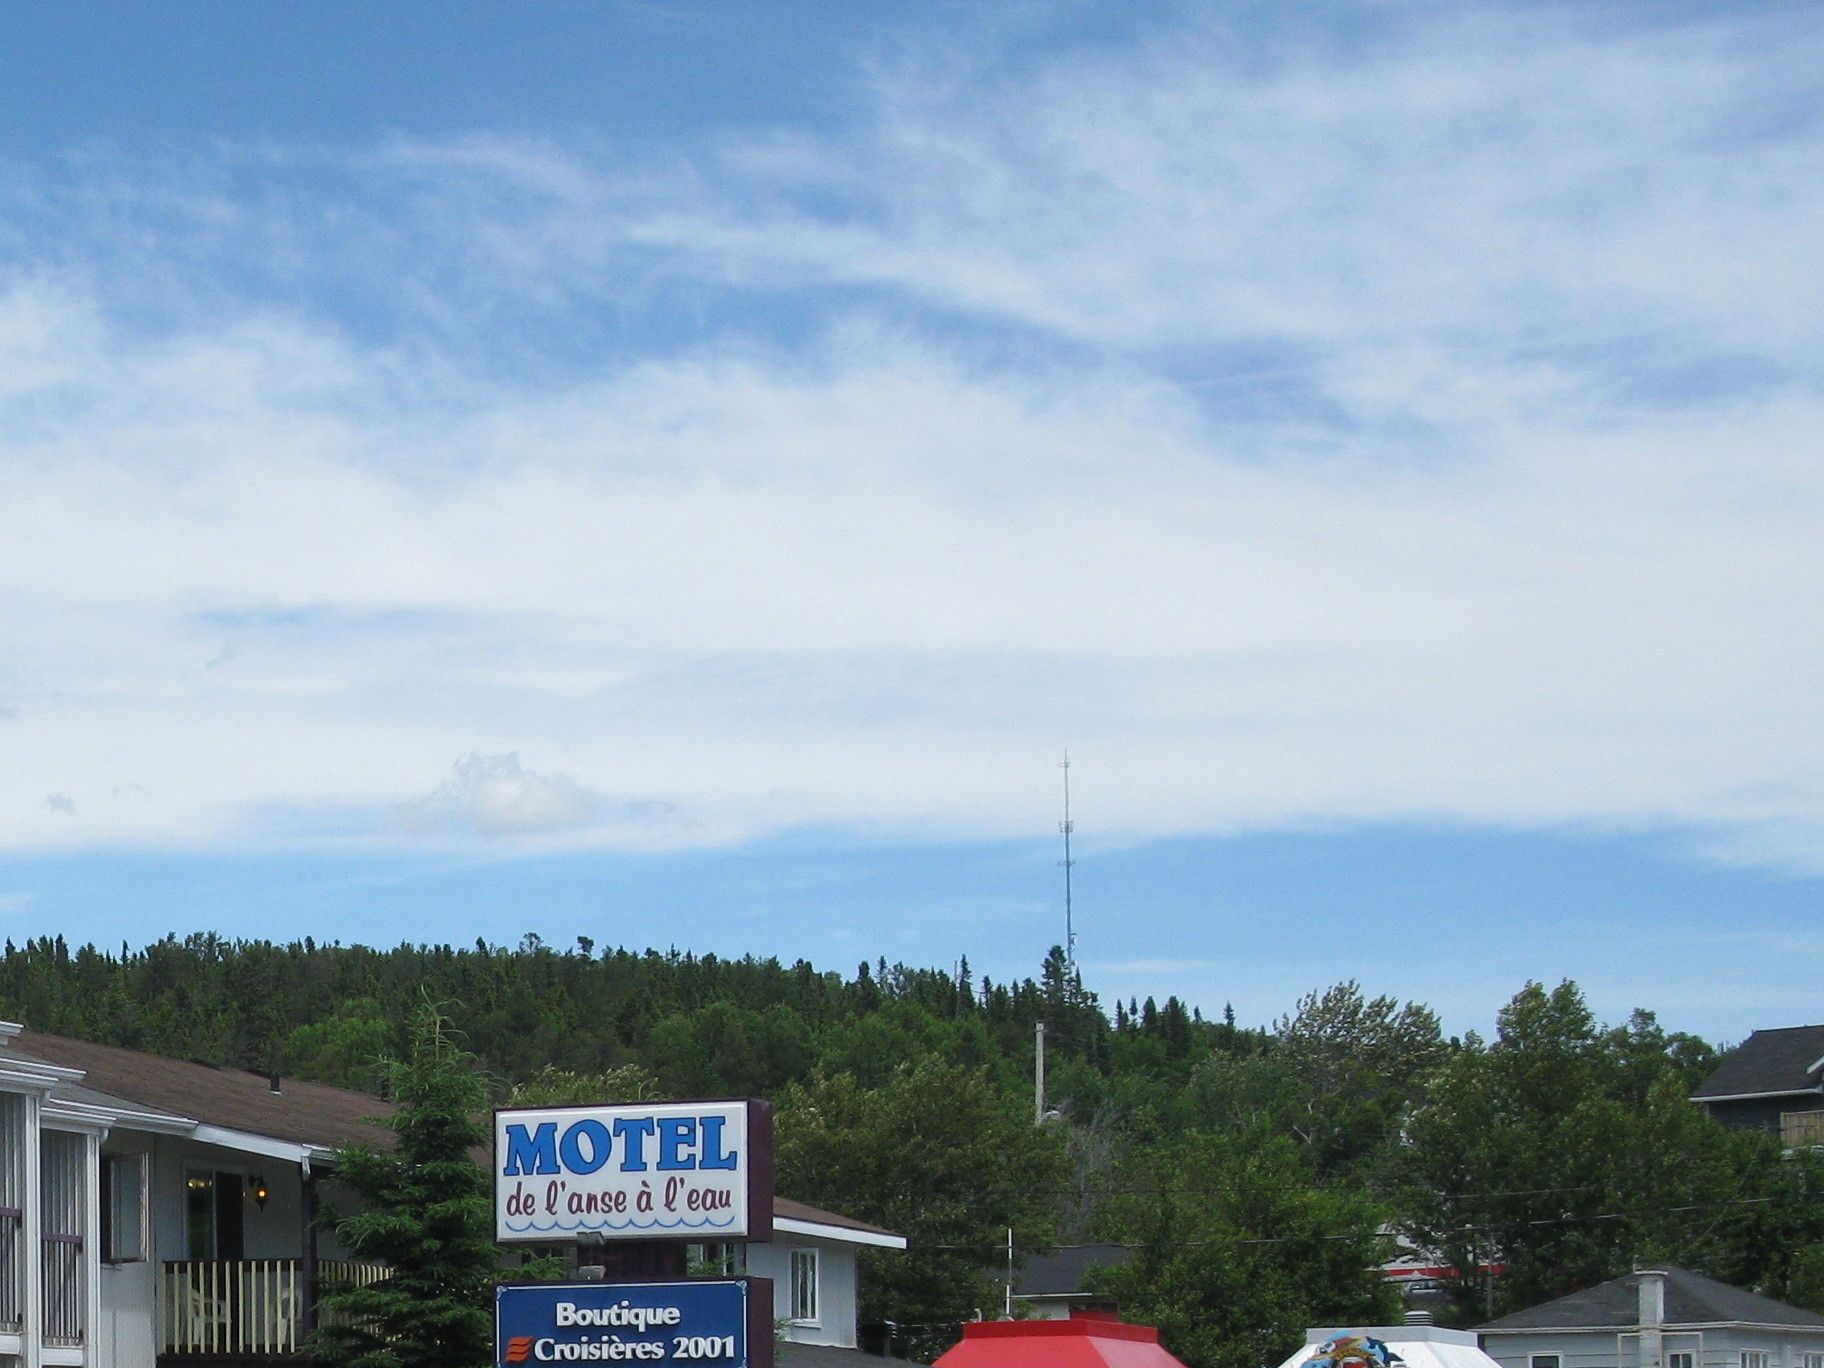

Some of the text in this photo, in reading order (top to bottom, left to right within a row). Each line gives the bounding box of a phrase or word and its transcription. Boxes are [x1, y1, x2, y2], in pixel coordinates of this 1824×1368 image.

[503, 1115, 738, 1177] MOTEL
[506, 1176, 733, 1217] de l'anse à l'eau
[556, 1300, 681, 1332] Boutique
[534, 1335, 736, 1361] Croisières 2001
